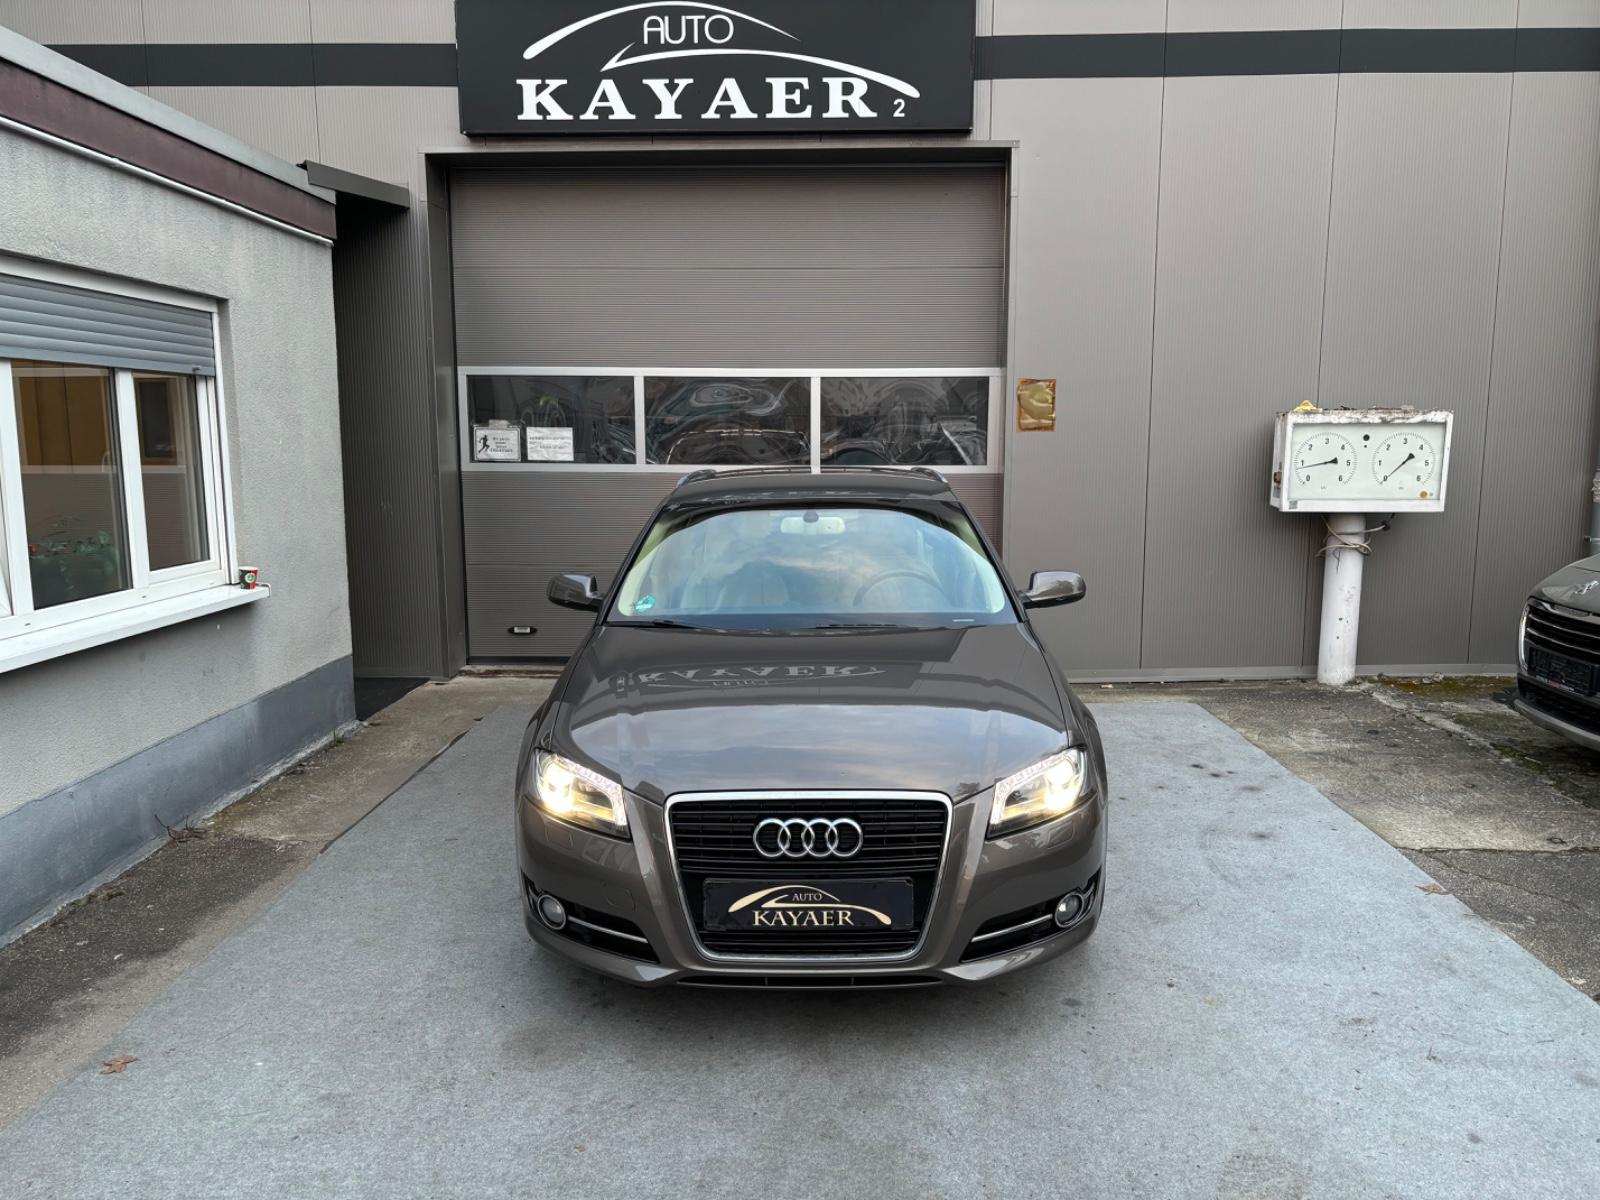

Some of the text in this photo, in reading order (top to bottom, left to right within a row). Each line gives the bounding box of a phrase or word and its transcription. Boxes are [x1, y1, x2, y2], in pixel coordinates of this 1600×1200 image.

[643, 14, 734, 44] AUTO
[515, 77, 906, 121] KAYAER 2
[792, 893, 823, 902] AUTO
[752, 910, 855, 926] KAYAER
